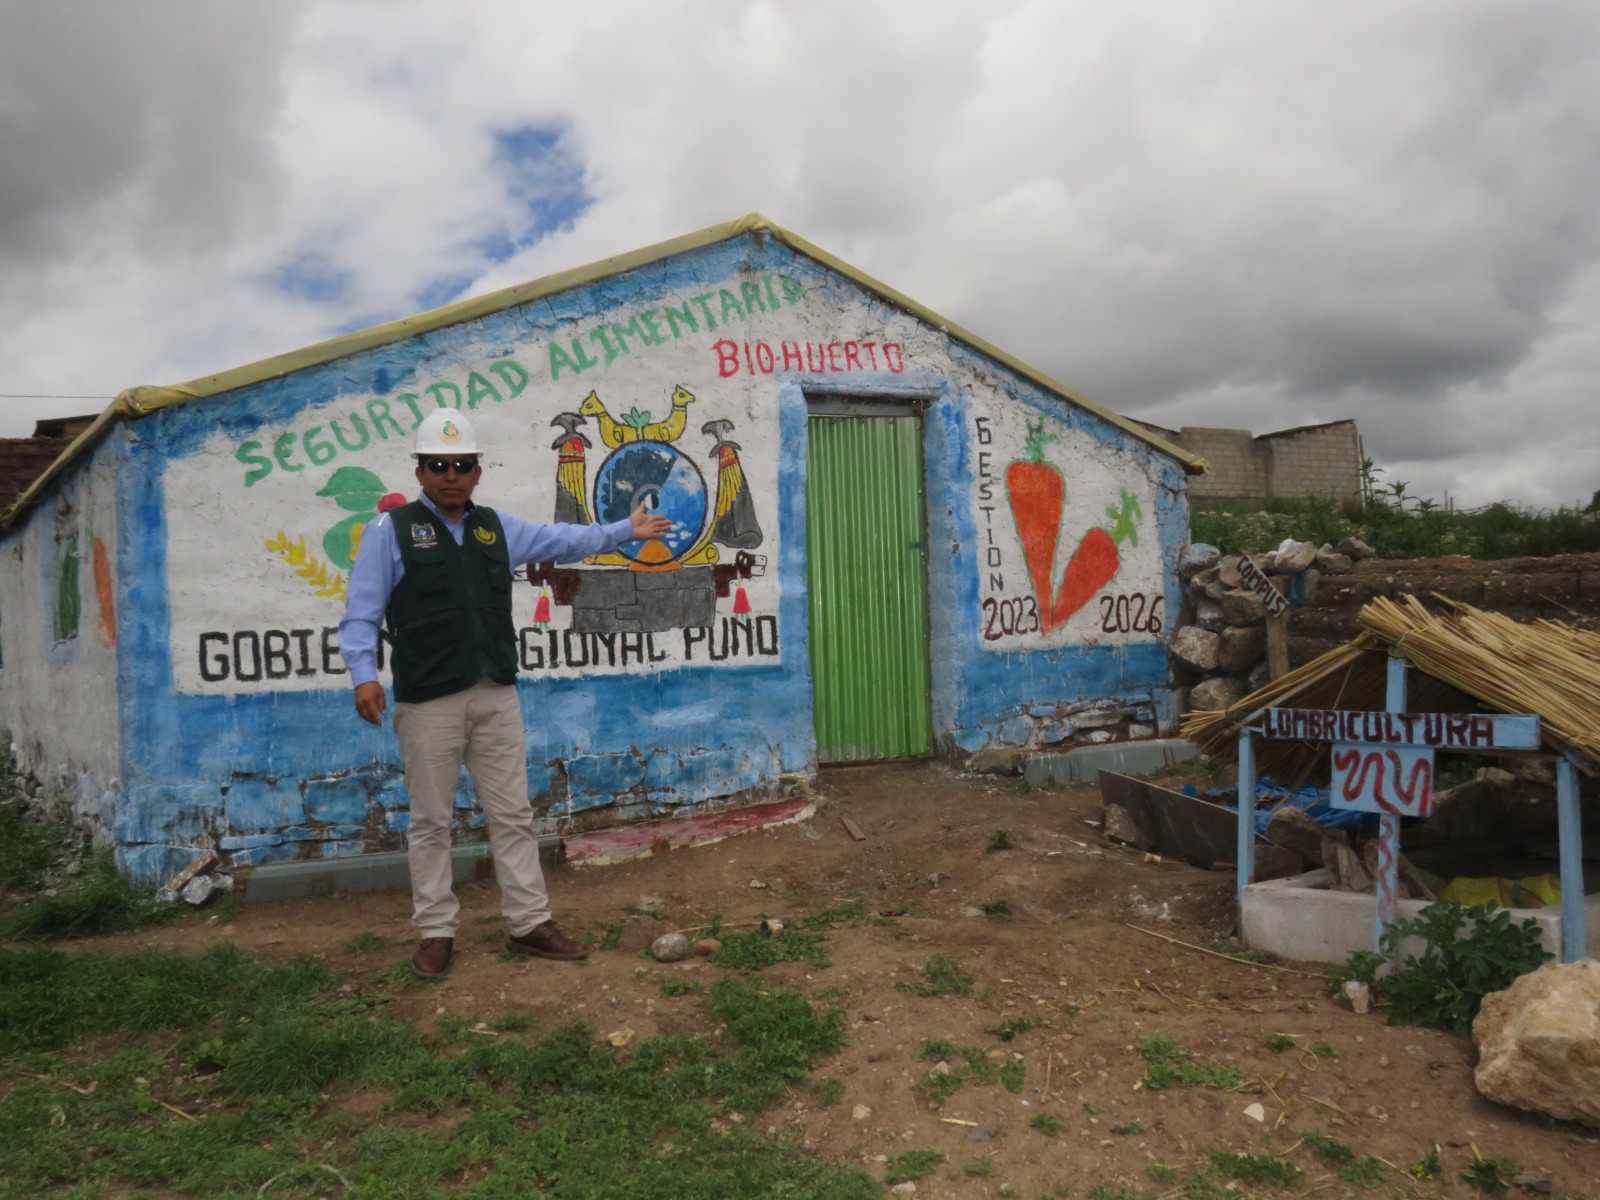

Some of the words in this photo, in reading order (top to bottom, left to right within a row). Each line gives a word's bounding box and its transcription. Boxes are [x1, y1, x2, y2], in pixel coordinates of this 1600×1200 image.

[234, 358, 529, 487] SEGURIDAD
[983, 596, 1039, 640] 2023
[1101, 592, 1164, 633] 2026
[515, 625, 667, 671] GIONAL
[684, 615, 779, 660] PUNO
[1263, 708, 1495, 747] LOMBRICULTURA
